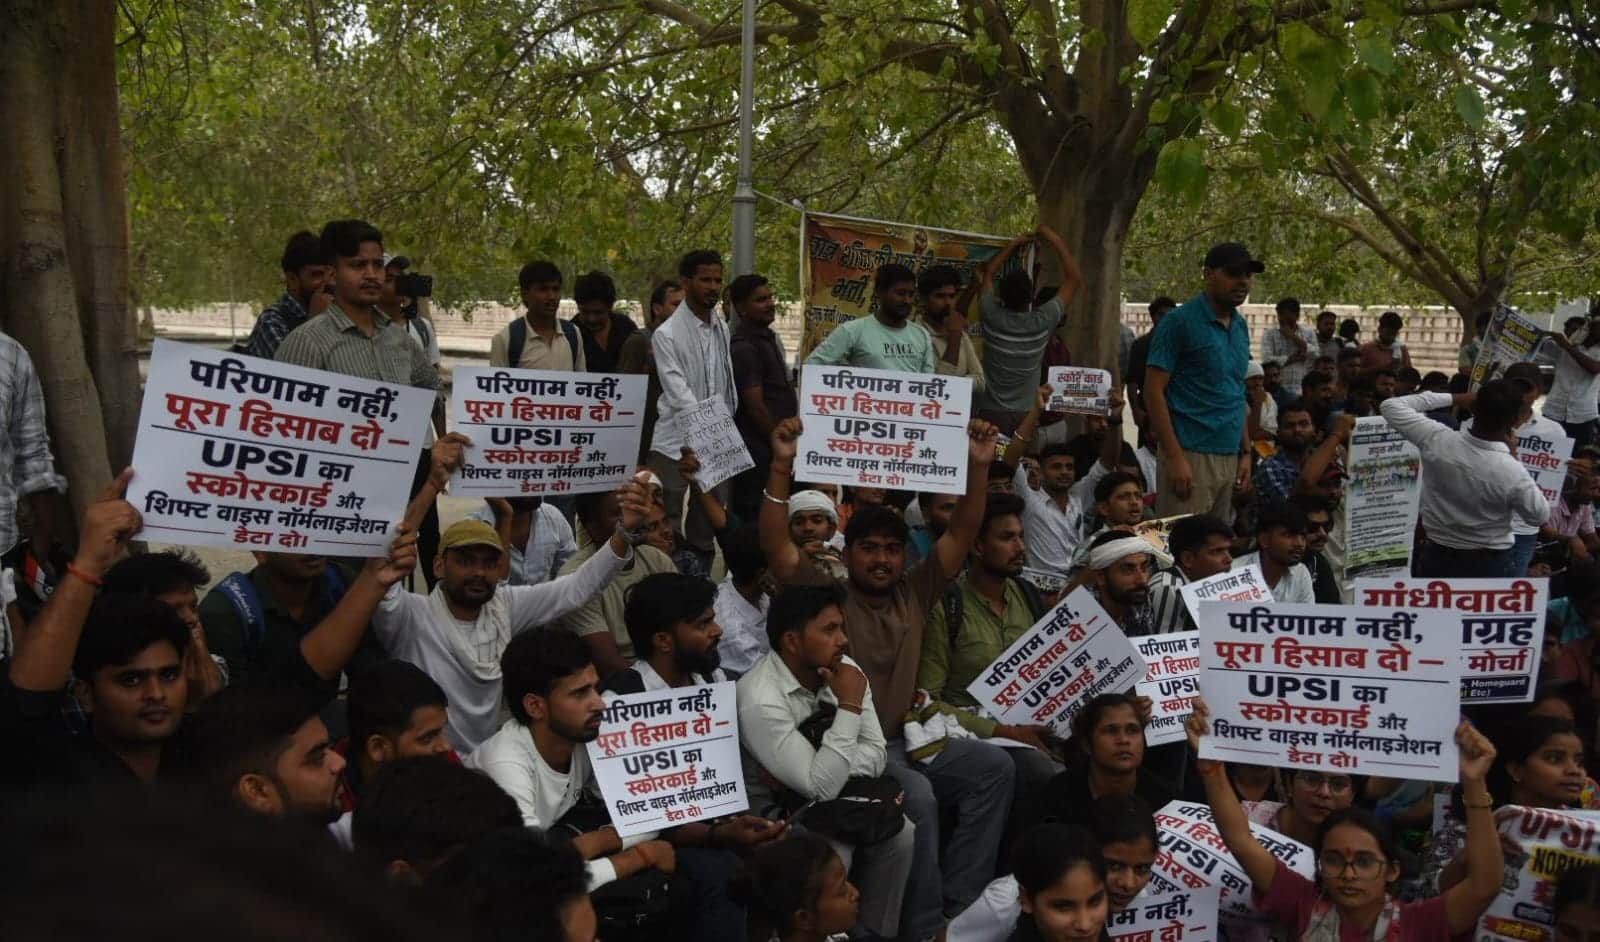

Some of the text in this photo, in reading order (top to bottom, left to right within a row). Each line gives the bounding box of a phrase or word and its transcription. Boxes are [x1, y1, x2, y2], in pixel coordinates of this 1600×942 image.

[190, 358, 399, 422] परिणाम नहीं,
[476, 372, 568, 397] परिणाम
[822, 370, 903, 394] परिणाम
[465, 400, 504, 423] पूरा
[510, 397, 584, 421] हिसाब
[589, 400, 613, 422] दो
[812, 394, 847, 415] पूरा
[852, 392, 915, 417] हिसाब
[920, 400, 942, 420] दो
[165, 394, 231, 431] पूरा
[239, 399, 344, 446] हिसाब
[351, 420, 383, 450] दो
[834, 418, 927, 442] UPSI का
[491, 427, 596, 447] UPSI का
[827, 437, 938, 460] स्कोरकार्ड और
[1519, 435, 1554, 454] ाहिए,
[201, 439, 354, 482] UPSI का
[484, 443, 607, 465] स्कोरकार्ड और
[806, 451, 957, 478] शिफ्ट वाइस नॉर्मलाइजेशन
[461, 462, 626, 481] शिफ्ट वाइस नॉर्मलाइजेशन
[858, 471, 882, 485] डेटा
[186, 470, 365, 510] स्कोरकार्ड और
[520, 480, 546, 493] डेटा
[144, 490, 389, 535] शिफ्ट वाइस नॉर्मलाइजेशन
[233, 527, 274, 545] डेटा
[1194, 576, 1240, 598] परिणाम
[1363, 580, 1536, 613] गांधीवादी
[1228, 607, 1424, 645] परिणाम नहीं,
[985, 635, 1044, 689] परिणाम
[1139, 639, 1188, 657] परिणाम
[1214, 640, 1265, 669] पूरा
[1271, 637, 1370, 670] हिसाब
[1377, 643, 1411, 672] दो
[1468, 650, 1528, 673] मोर्चा
[993, 683, 1021, 707] पूरा
[1018, 640, 1068, 684] हिसाब
[1066, 623, 1088, 644] दो
[1022, 649, 1092, 708] UPSI का
[1032, 658, 1112, 722] स्कोरकार्ड और
[1248, 675, 1388, 705] UPSI का
[600, 688, 717, 724] परिणाम नहीं,
[1240, 698, 1409, 731] स्कोरकार्ड और
[597, 731, 626, 757] पूरा
[630, 721, 687, 747] हिसाब
[692, 713, 712, 736] दो
[1213, 719, 1442, 757] शिफ्ट वाइस नॉर्मलाइजेशन
[622, 748, 703, 775] UPSI का
[1287, 747, 1322, 766] डेटा
[625, 763, 717, 797] स्कोरकार्ड और
[616, 781, 737, 817] शिफ्ट वाइस नॉर्मलाइजेशन
[665, 808, 686, 822] डेटा
[1520, 806, 1595, 851] UPSI
[1158, 831, 1218, 875] UPSI
[1221, 870, 1248, 895] का
[1144, 894, 1193, 920] नहीं,
